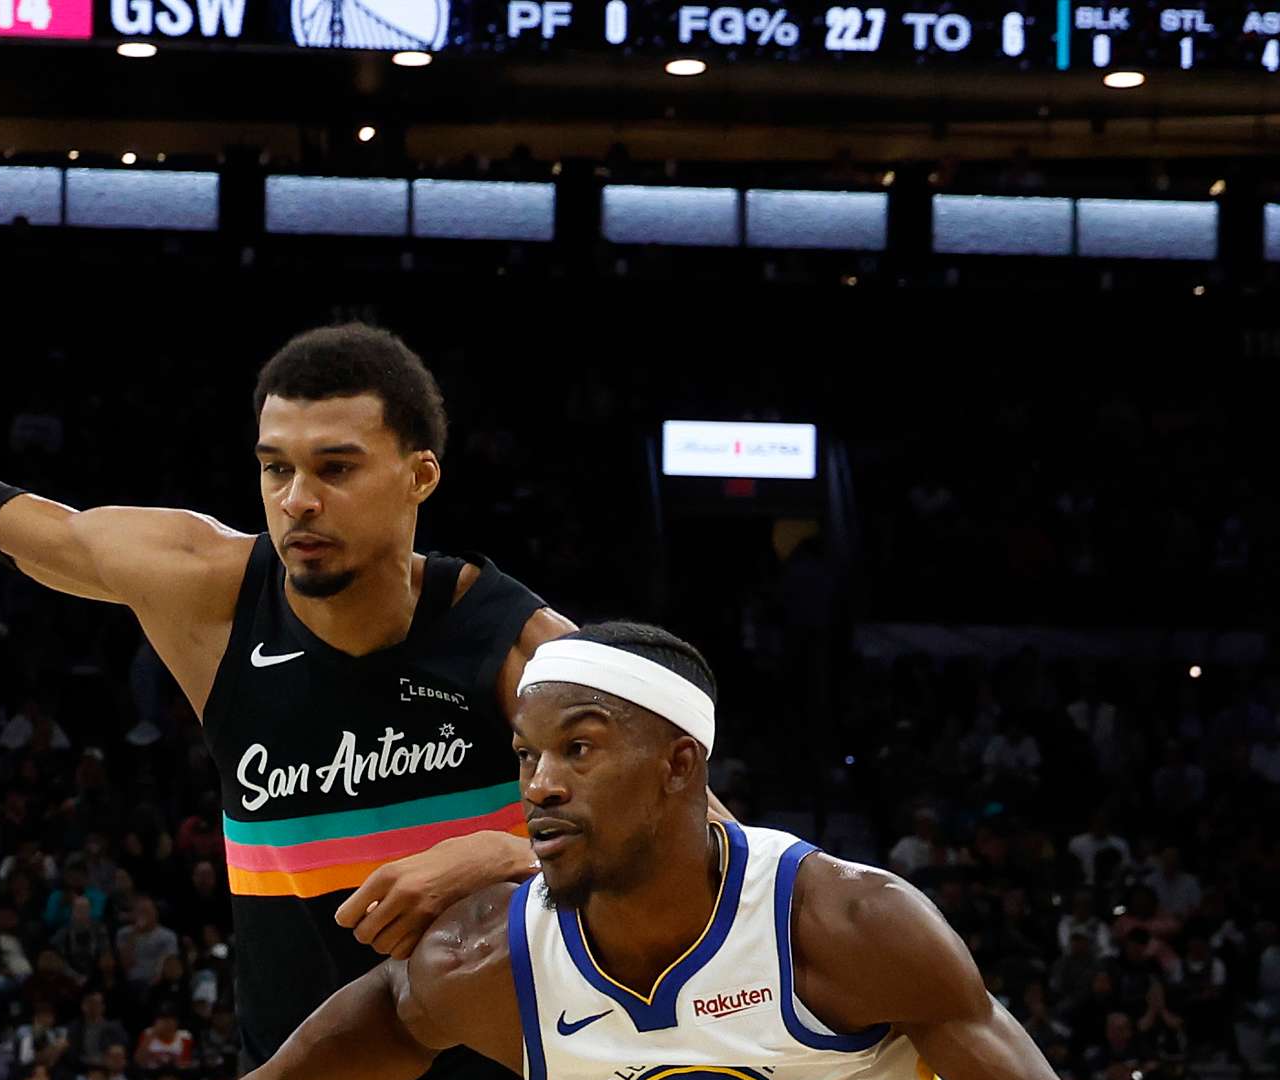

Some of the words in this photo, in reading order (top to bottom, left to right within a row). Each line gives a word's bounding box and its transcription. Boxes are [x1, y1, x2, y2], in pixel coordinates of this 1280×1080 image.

[111, 0, 246, 37] GSW
[507, 1, 572, 39] PF
[678, 5, 800, 47] FG%
[901, 13, 972, 51] TO
[1074, 6, 1131, 30] BLK
[1159, 8, 1215, 32] STL
[409, 685, 460, 704] LEDGER
[236, 743, 309, 811] San
[316, 726, 474, 797] Antonio
[692, 986, 773, 1018] Rakuten
